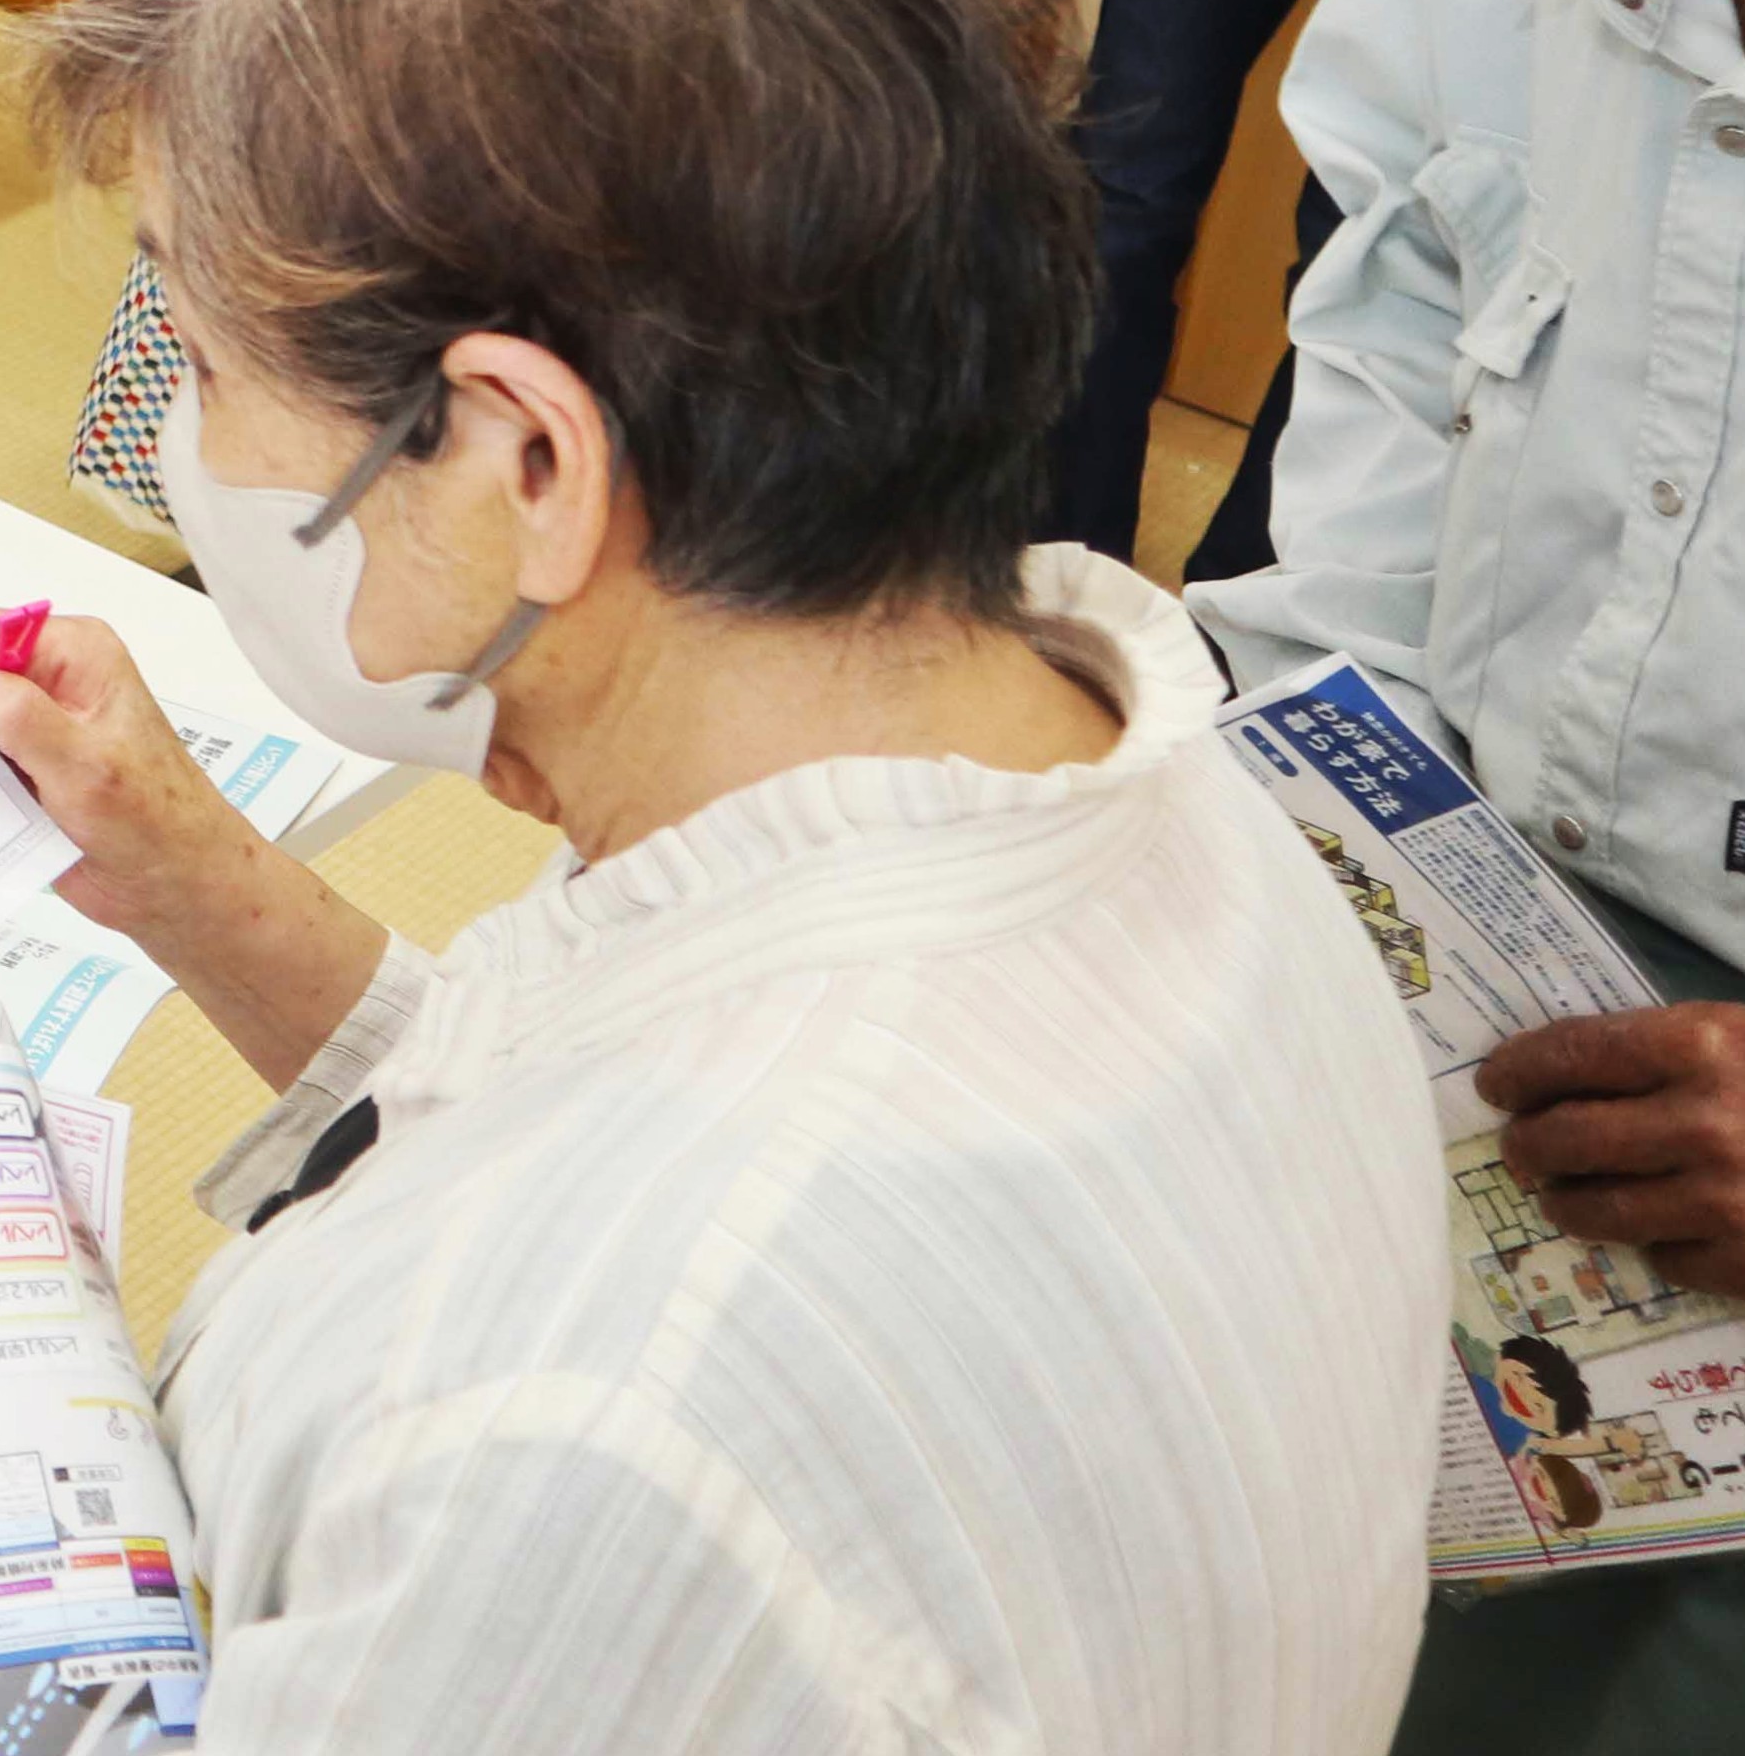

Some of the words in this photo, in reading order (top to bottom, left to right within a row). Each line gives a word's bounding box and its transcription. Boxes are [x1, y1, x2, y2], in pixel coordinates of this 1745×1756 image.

[1283, 708, 1403, 819] 暮らす方法
[1313, 701, 1411, 781] わが家で
